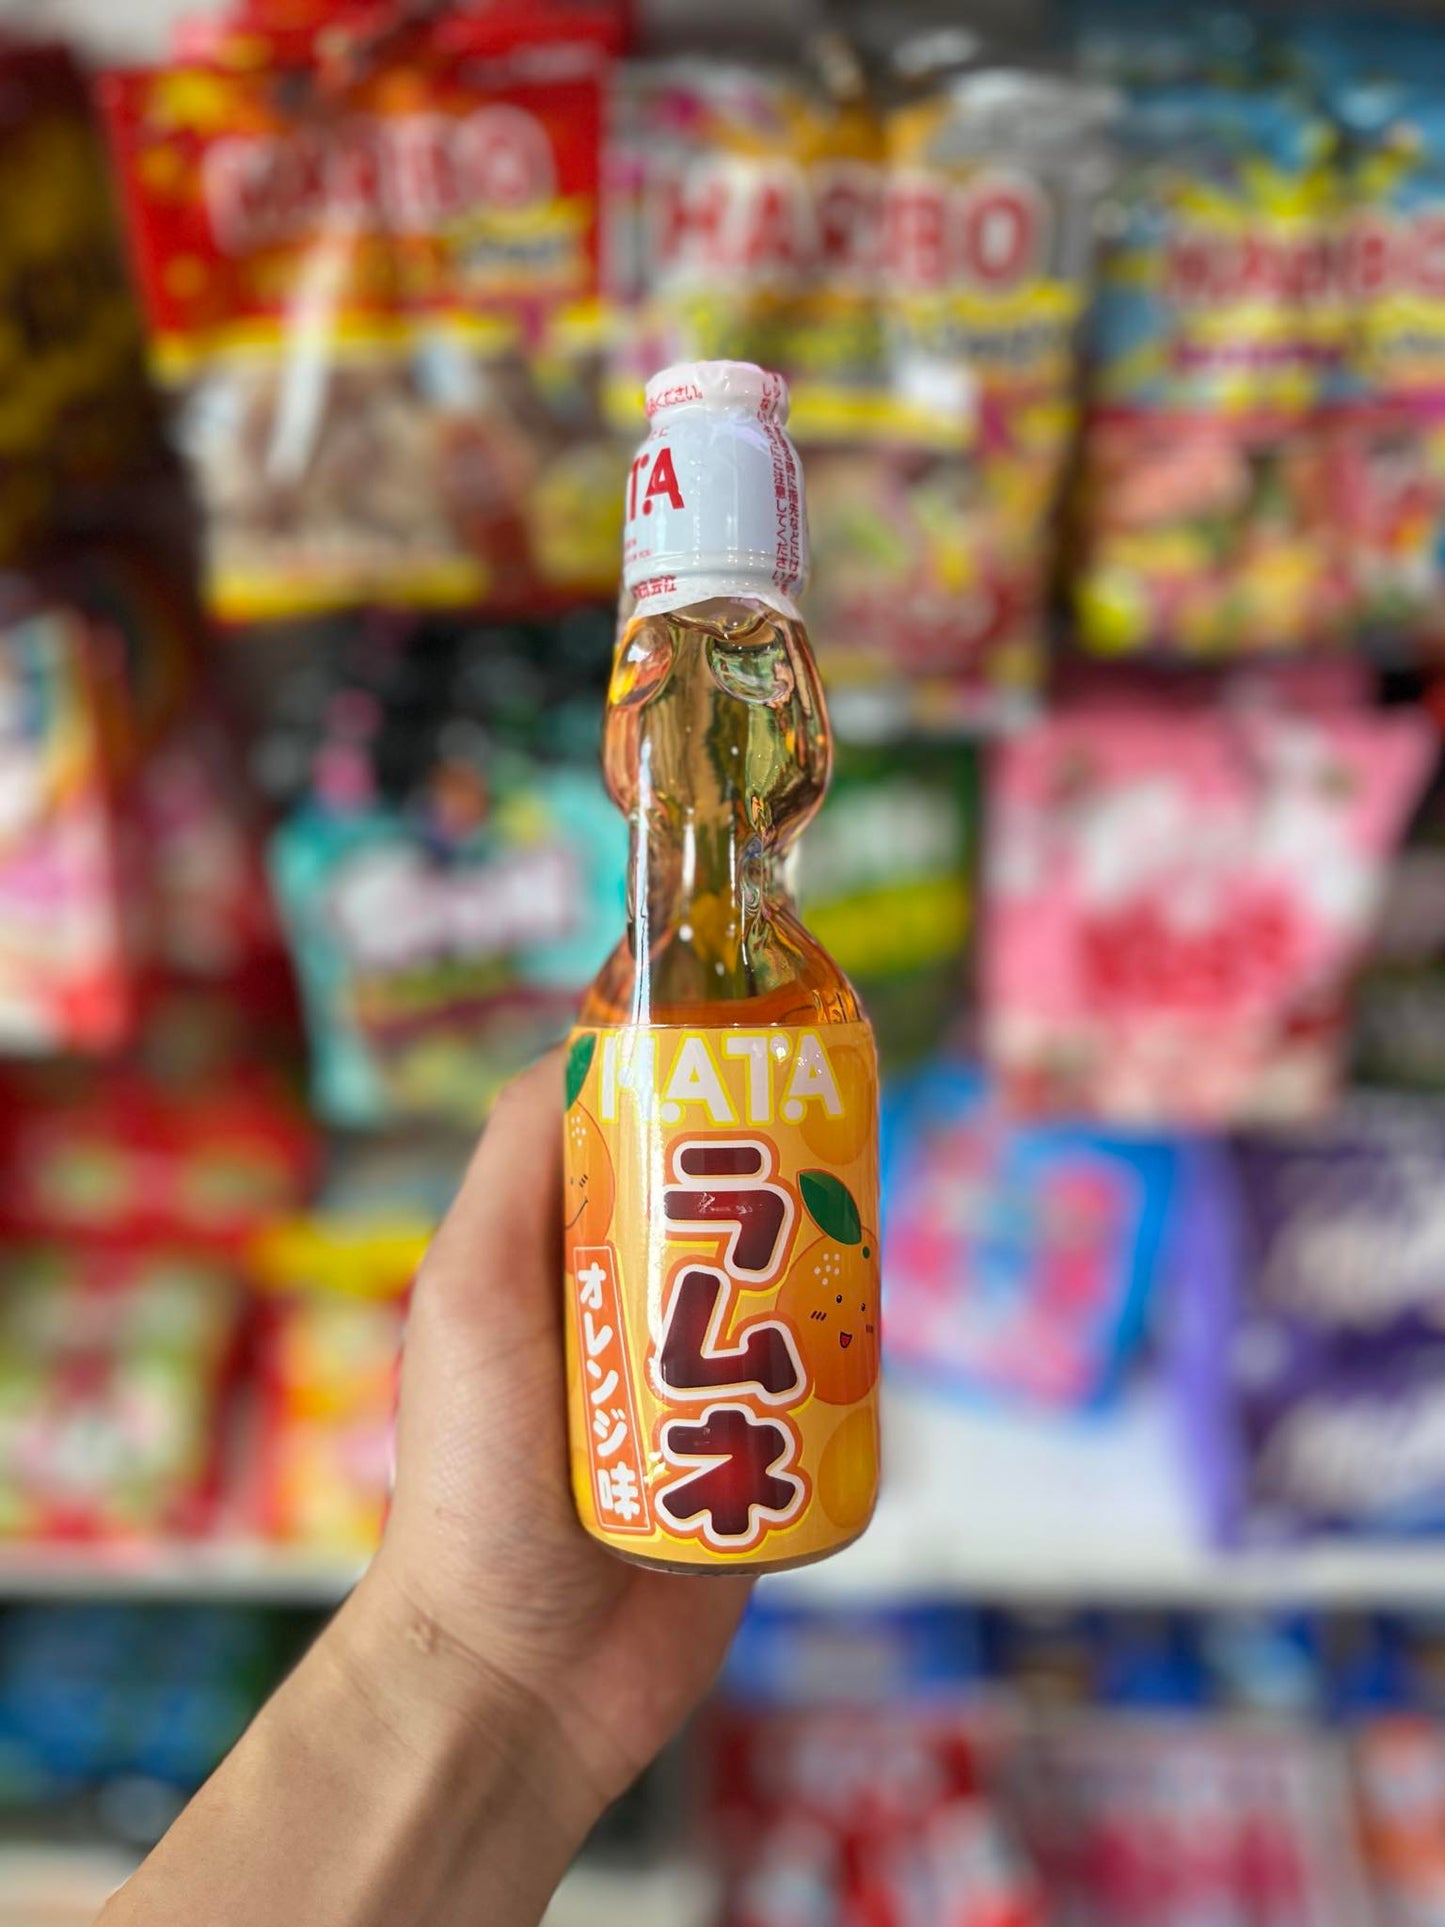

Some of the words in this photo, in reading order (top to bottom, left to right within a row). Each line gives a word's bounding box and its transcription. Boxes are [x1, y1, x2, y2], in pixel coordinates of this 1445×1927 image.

[599, 1030, 844, 1125] HATA
[577, 1262, 641, 1520] オレンジ味
[655, 1140, 807, 1546] ラムネ
